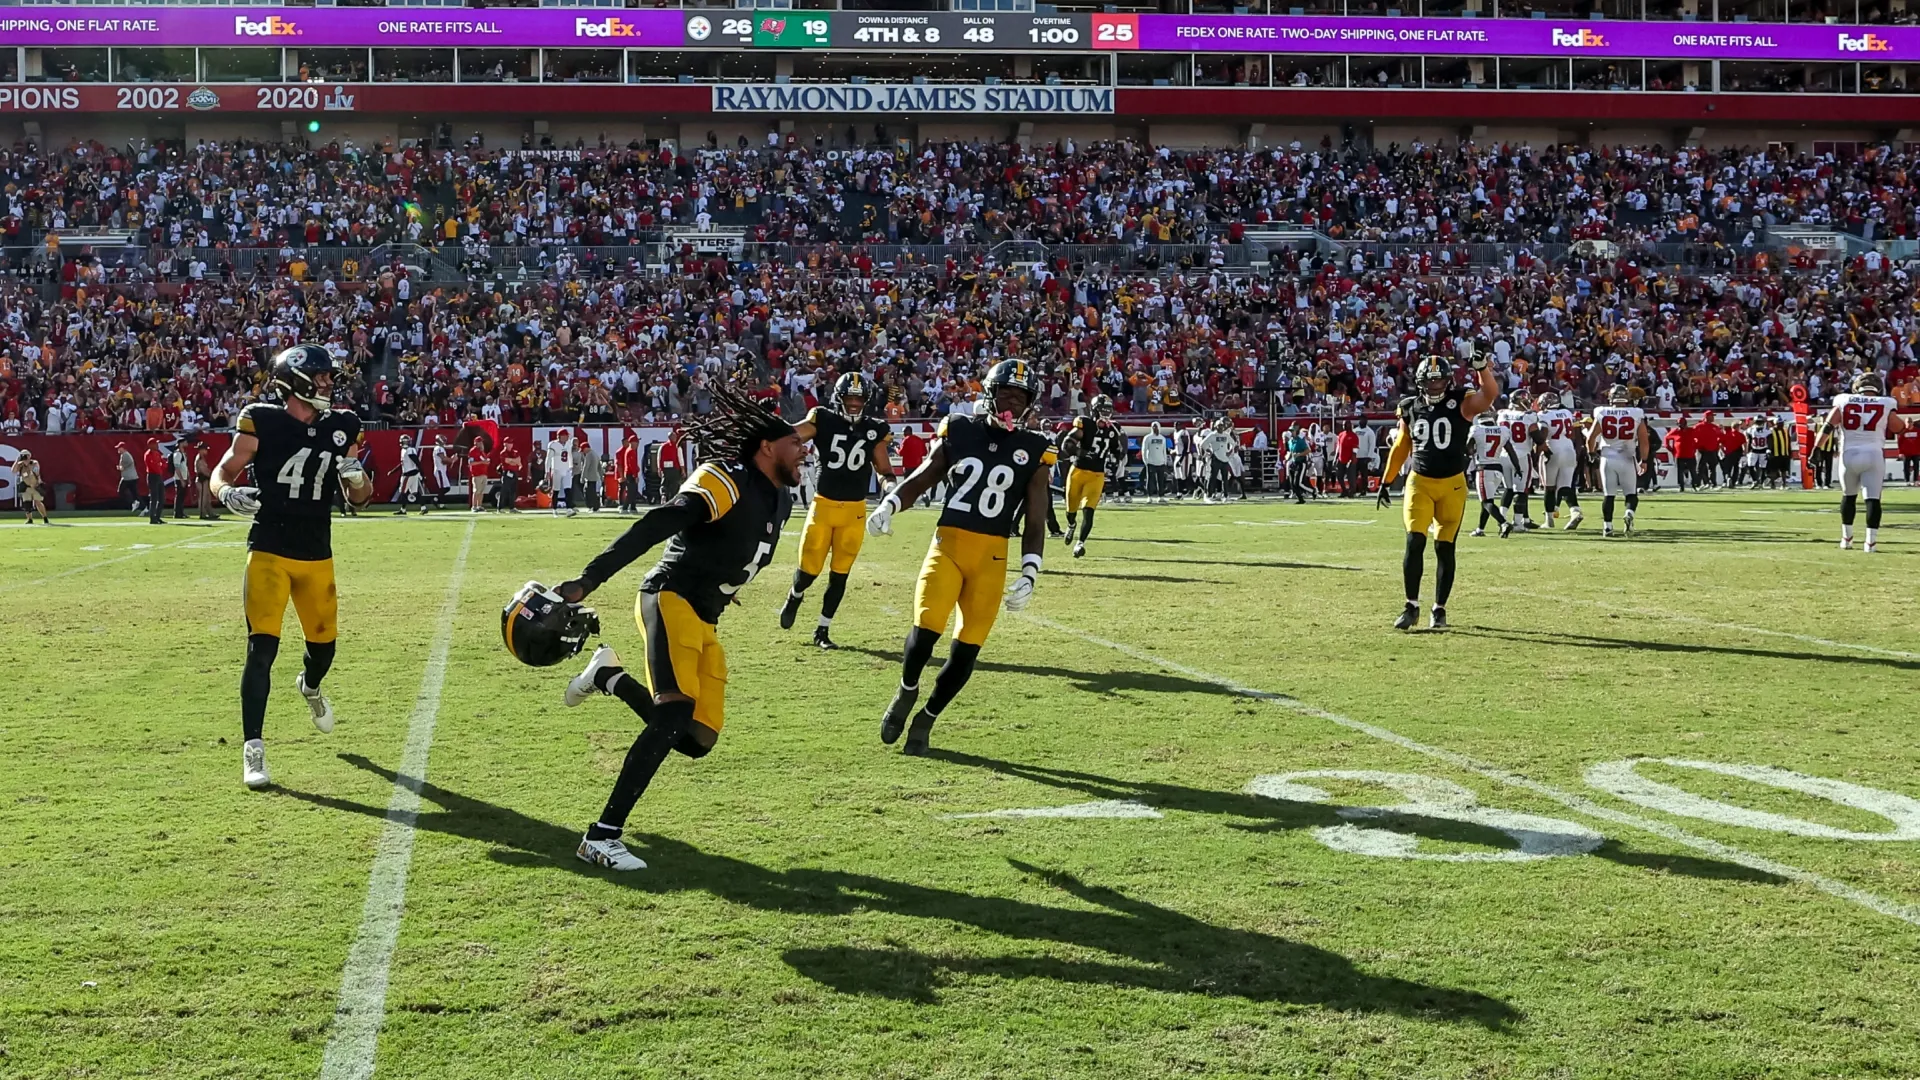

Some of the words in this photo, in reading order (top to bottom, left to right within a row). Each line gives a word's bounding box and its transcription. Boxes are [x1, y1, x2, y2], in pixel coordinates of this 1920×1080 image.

[0, 19, 54, 33] HIPPING,
[56, 19, 86, 32] ONE
[88, 19, 121, 32] FLAT
[122, 19, 160, 32] RATE.
[378, 21, 408, 33] ONE
[409, 21, 443, 33] RATE
[445, 21, 473, 33] FITS
[474, 21, 503, 33] ALL.
[721, 19, 753, 35] 26
[802, 20, 828, 35] 19
[858, 16, 884, 25] DOWN
[884, 16, 891, 25] &
[892, 16, 929, 25] DISTANCE
[963, 17, 981, 25] BALL
[981, 17, 995, 25] ON
[1032, 17, 1072, 25] OVERTIME
[853, 27, 899, 43] 4TH
[902, 27, 921, 43] &
[924, 27, 941, 43] 8
[963, 27, 995, 43] 48
[1028, 27, 1079, 44] 1:00
[1097, 23, 1133, 42] 25
[1176, 26, 1216, 38] FEDEX
[1217, 27, 1244, 38] ONE
[1245, 27, 1279, 39] RATE.
[1280, 28, 1338, 39] TWO-DAY
[1340, 28, 1398, 42] SHIPPING,
[1399, 29, 1425, 41] ONE
[1426, 30, 1455, 41] FLAT
[1456, 30, 1489, 42] RATE.
[1673, 34, 1698, 46] ONE
[1699, 35, 1728, 46] RATE
[1729, 35, 1753, 47] FITS
[1753, 36, 1778, 47] ALL.
[0, 87, 80, 110] PIONS
[116, 87, 180, 110] 2002
[256, 87, 319, 110] 2020
[715, 86, 872, 111] RAYMOND
[876, 86, 977, 112] JAMES
[984, 87, 1113, 112] STADIUM
[1718, 391, 1729, 400] 36
[165, 413, 176, 422] 54
[486, 410, 496, 420] 14
[1842, 403, 1885, 432] 67
[1412, 416, 1452, 450] 90
[1550, 418, 1573, 440] 78
[1601, 415, 1636, 440] 62
[827, 433, 867, 472] 56
[1091, 436, 1111, 459] 51
[1485, 434, 1501, 457] 7
[561, 450, 569, 462] 9
[276, 446, 333, 501] 41
[946, 456, 1015, 519] 28
[718, 540, 772, 595] 5
